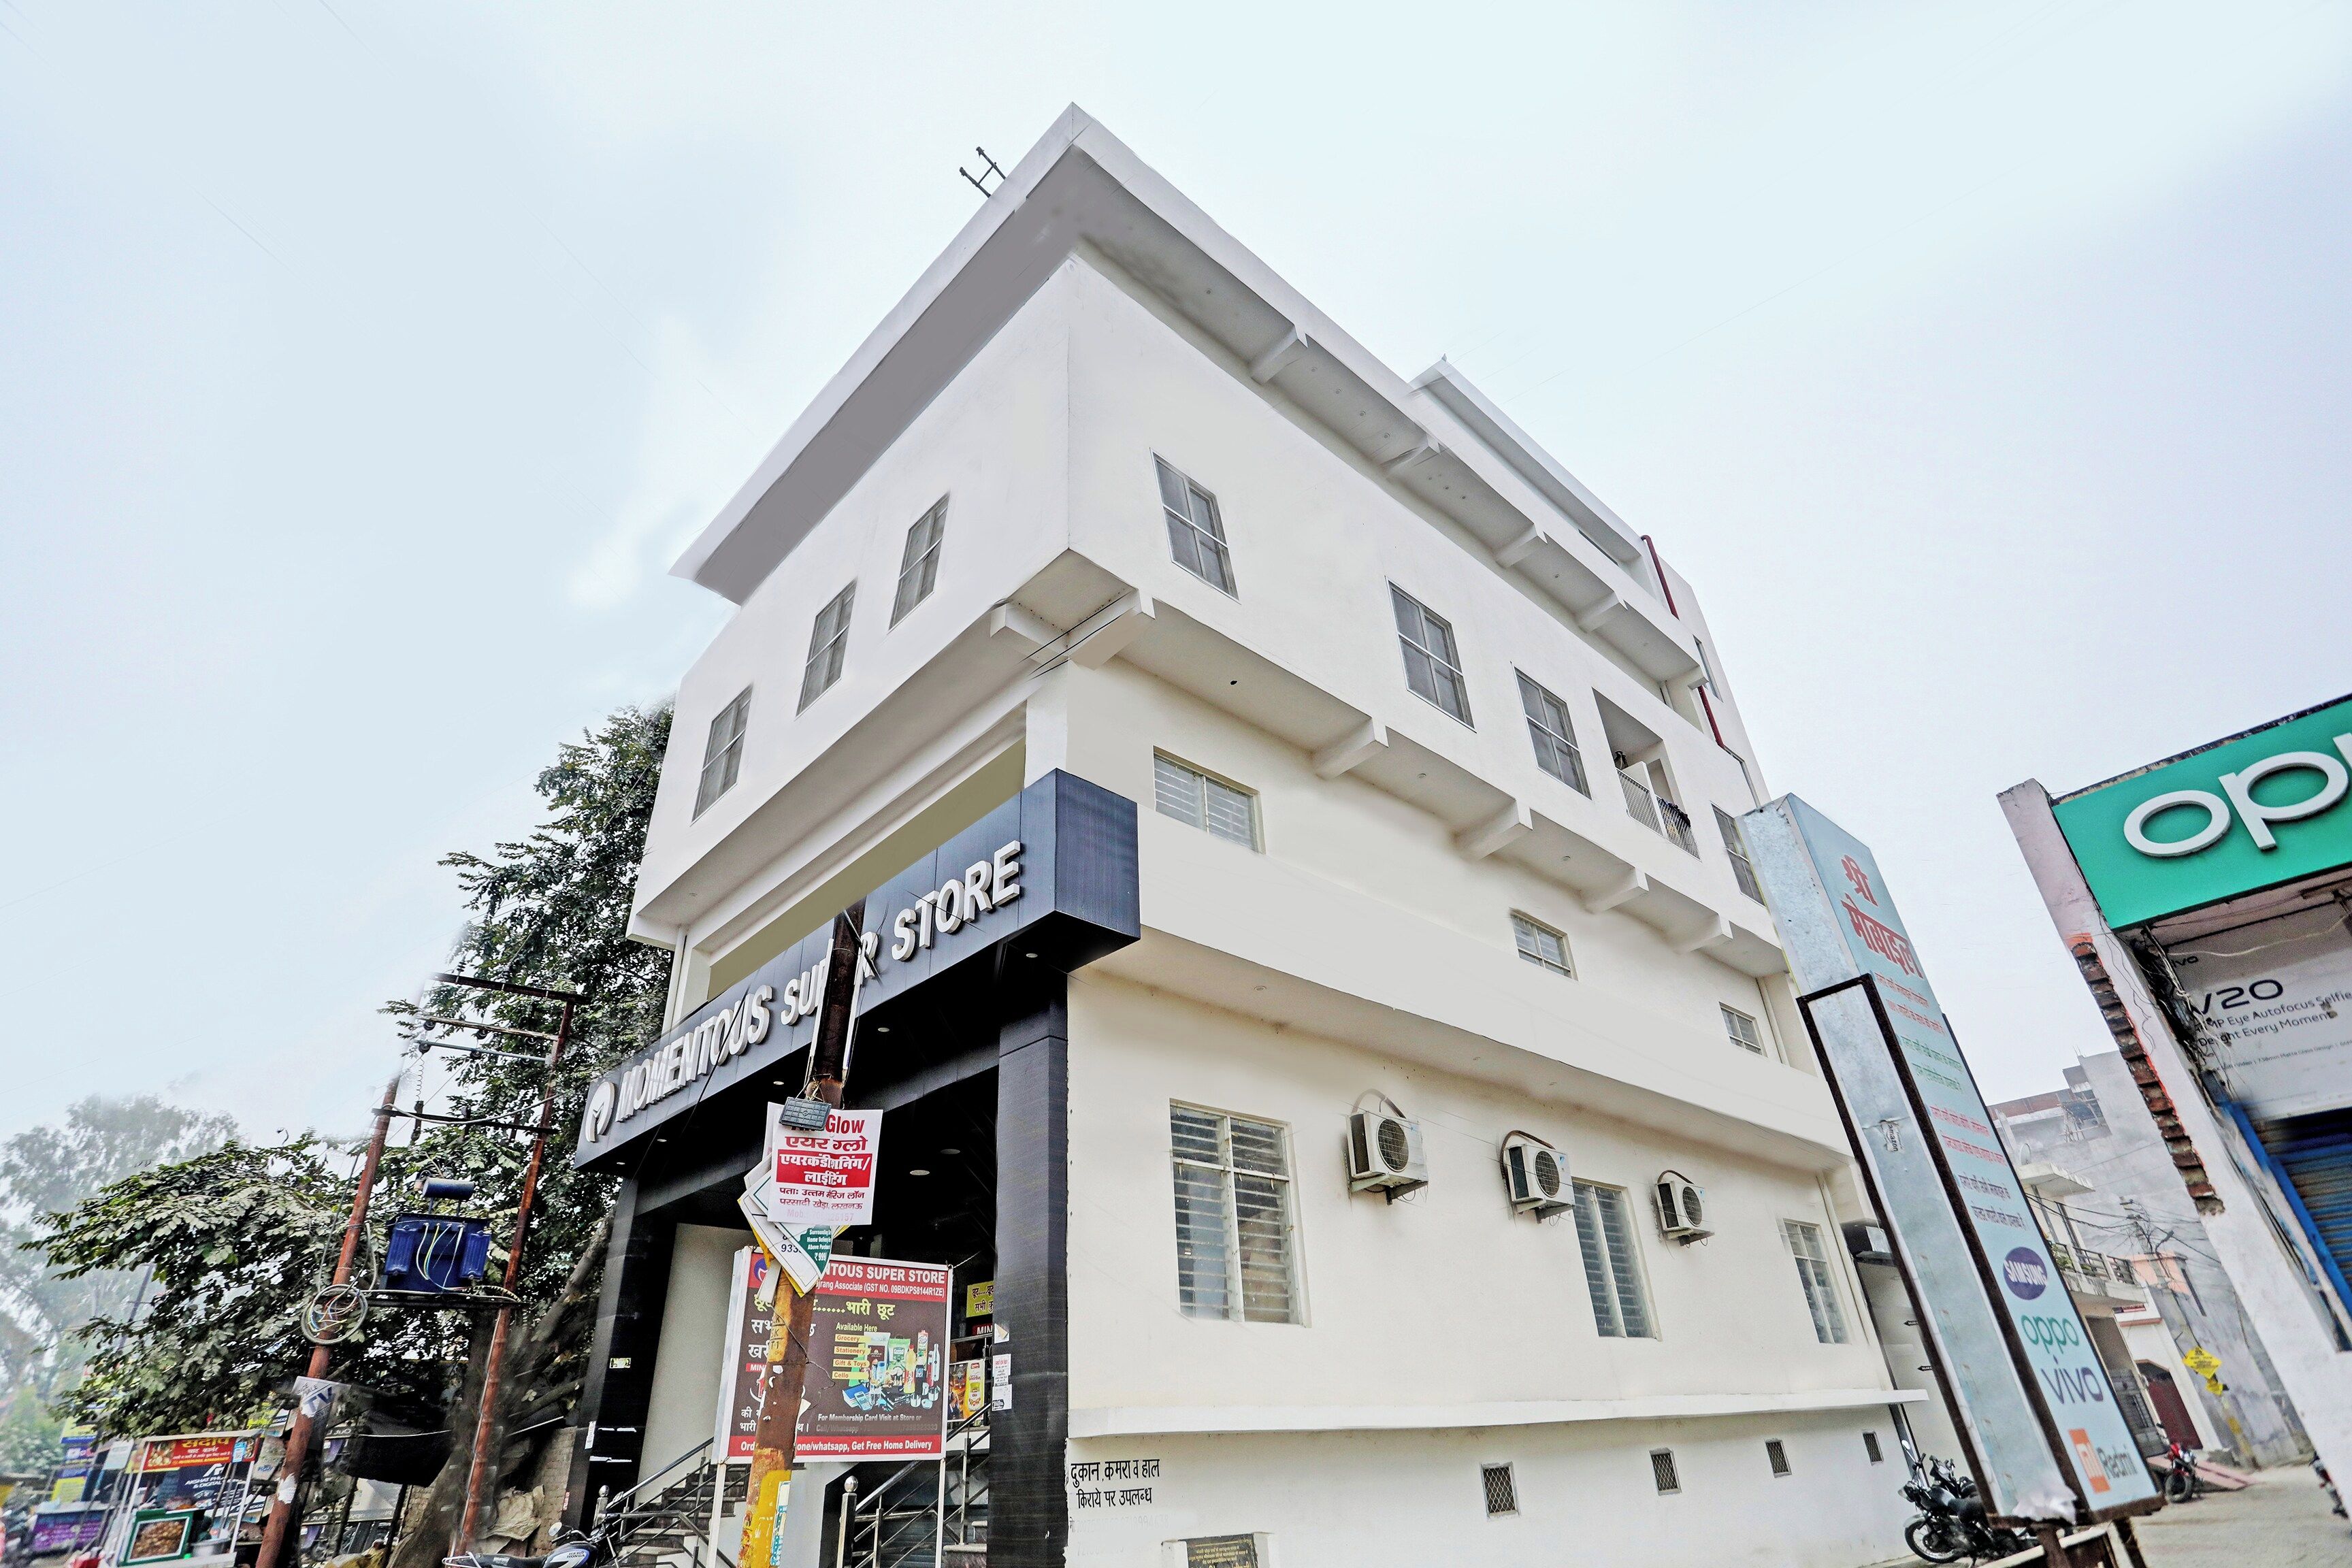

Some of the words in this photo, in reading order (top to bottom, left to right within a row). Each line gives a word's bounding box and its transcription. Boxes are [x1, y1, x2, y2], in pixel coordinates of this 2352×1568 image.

[2123, 733, 2352, 858] op
[1841, 854, 1878, 906] श्री
[2172, 956, 2199, 968] ivo
[615, 985, 772, 1123] MOMENTOUS
[781, 932, 878, 1026] SUR
[892, 840, 1021, 962] STORE
[2190, 979, 2284, 1015] V20
[2227, 1015, 2249, 1026] Eye
[2253, 1000, 2315, 1020] Autofocus
[2316, 991, 2352, 1005] Selfie
[2243, 1024, 2278, 1038] Every
[2280, 1011, 2333, 1030] Moment
[826, 1114, 865, 1134] Glow
[785, 1137, 830, 1149] एयर
[832, 1136, 868, 1151] ग्लो
[802, 1189, 824, 1197] उत्तम
[847, 1190, 865, 1198] लॉन
[781, 1244, 801, 1254] 933
[826, 1262, 863, 1279] NTOUS
[866, 1267, 904, 1281] SUPER
[909, 1270, 945, 1284] STORE
[2004, 1260, 2047, 1286] SAMSUNG
[815, 1279, 834, 1290] ajrang
[834, 1280, 863, 1292] Associate
[877, 1303, 896, 1320] छूट
[836, 1322, 863, 1331] Available
[864, 1324, 878, 1332] Here
[2021, 1314, 2079, 1354] oppo
[836, 1348, 866, 1356] Stationery
[2042, 1354, 2104, 1405] vivo
[303, 1386, 332, 1413] TV
[740, 1419, 757, 1432] भारी
[829, 1414, 864, 1422] Membership
[740, 1441, 756, 1451] Ord
[796, 1441, 849, 1452] one/whatsapp,
[851, 1441, 864, 1450] Get
[866, 1441, 881, 1450] Free
[883, 1440, 903, 1450] Home
[905, 1439, 932, 1450] Delivery
[1104, 1460, 1130, 1480] कमरा
[1132, 1460, 1139, 1479] व
[1141, 1458, 1160, 1477] हाल
[1076, 1488, 1101, 1509] किराये
[1104, 1490, 1116, 1507] पर
[1119, 1488, 1152, 1506] उपलब्ध
